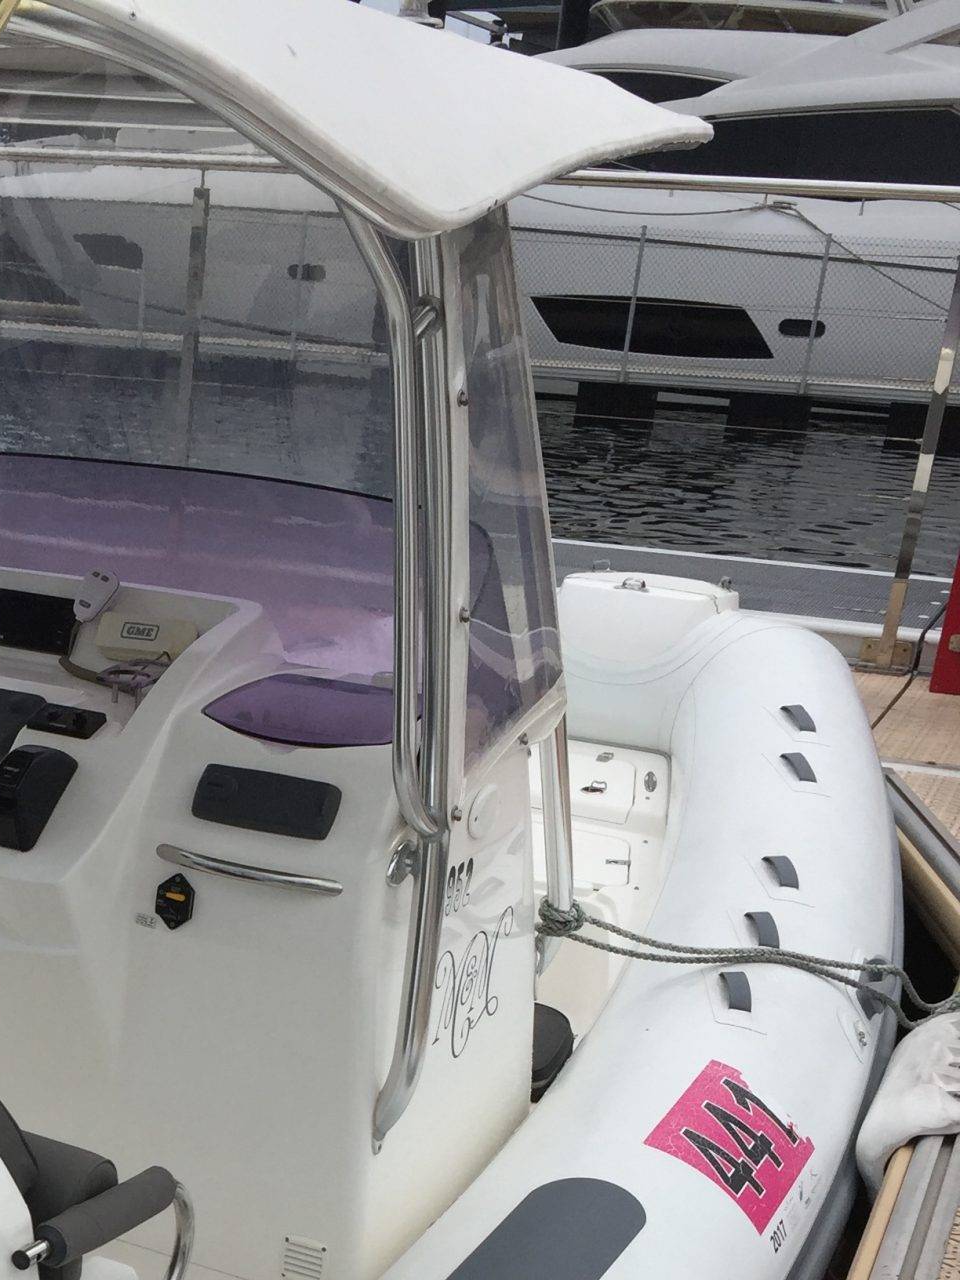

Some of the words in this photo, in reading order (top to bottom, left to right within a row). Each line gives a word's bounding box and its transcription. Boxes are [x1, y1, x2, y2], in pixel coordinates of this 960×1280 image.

[126, 626, 154, 637] GME
[680, 1076, 799, 1198] 441
[770, 1219, 787, 1254] 2017
